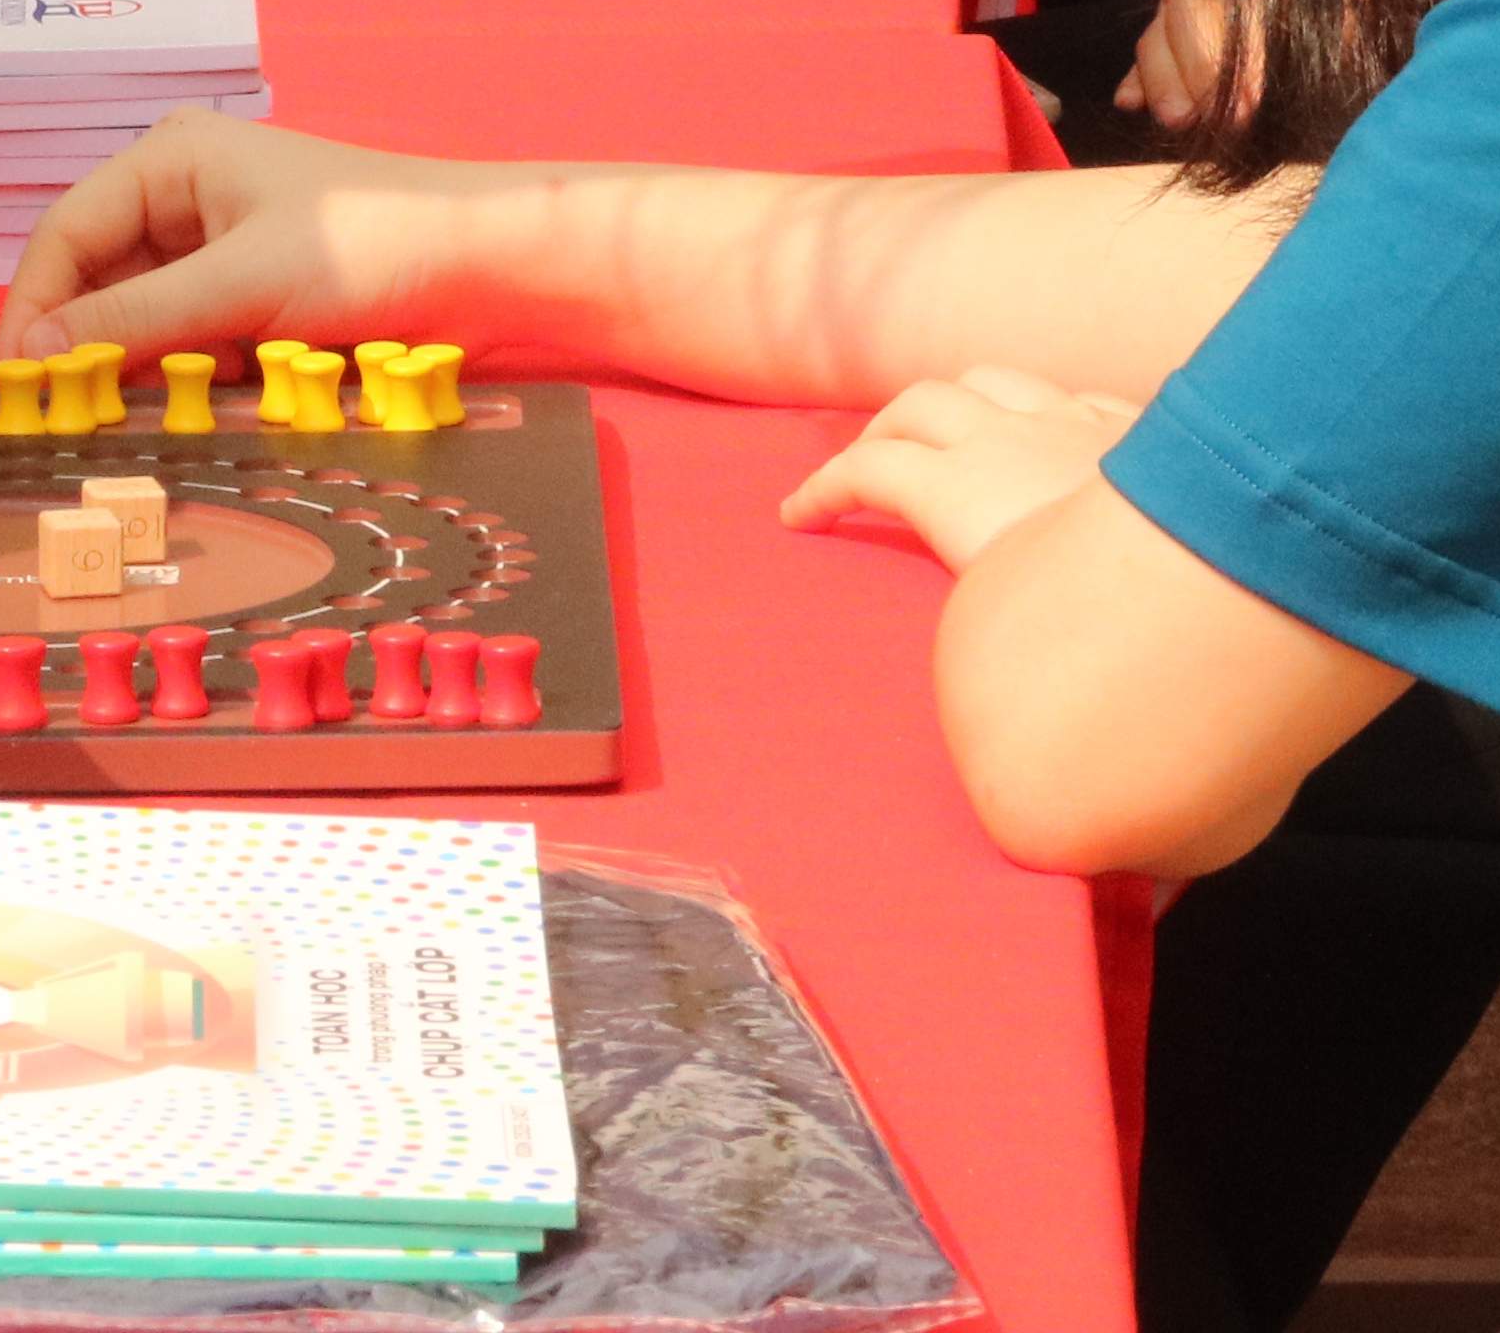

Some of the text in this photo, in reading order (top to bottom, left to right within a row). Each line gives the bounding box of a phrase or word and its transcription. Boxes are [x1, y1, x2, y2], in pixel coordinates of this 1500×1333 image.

[404, 946, 457, 984] LỚP
[301, 969, 355, 1055] TOÁN HỌC
[419, 1028, 470, 1079] CHỤP
